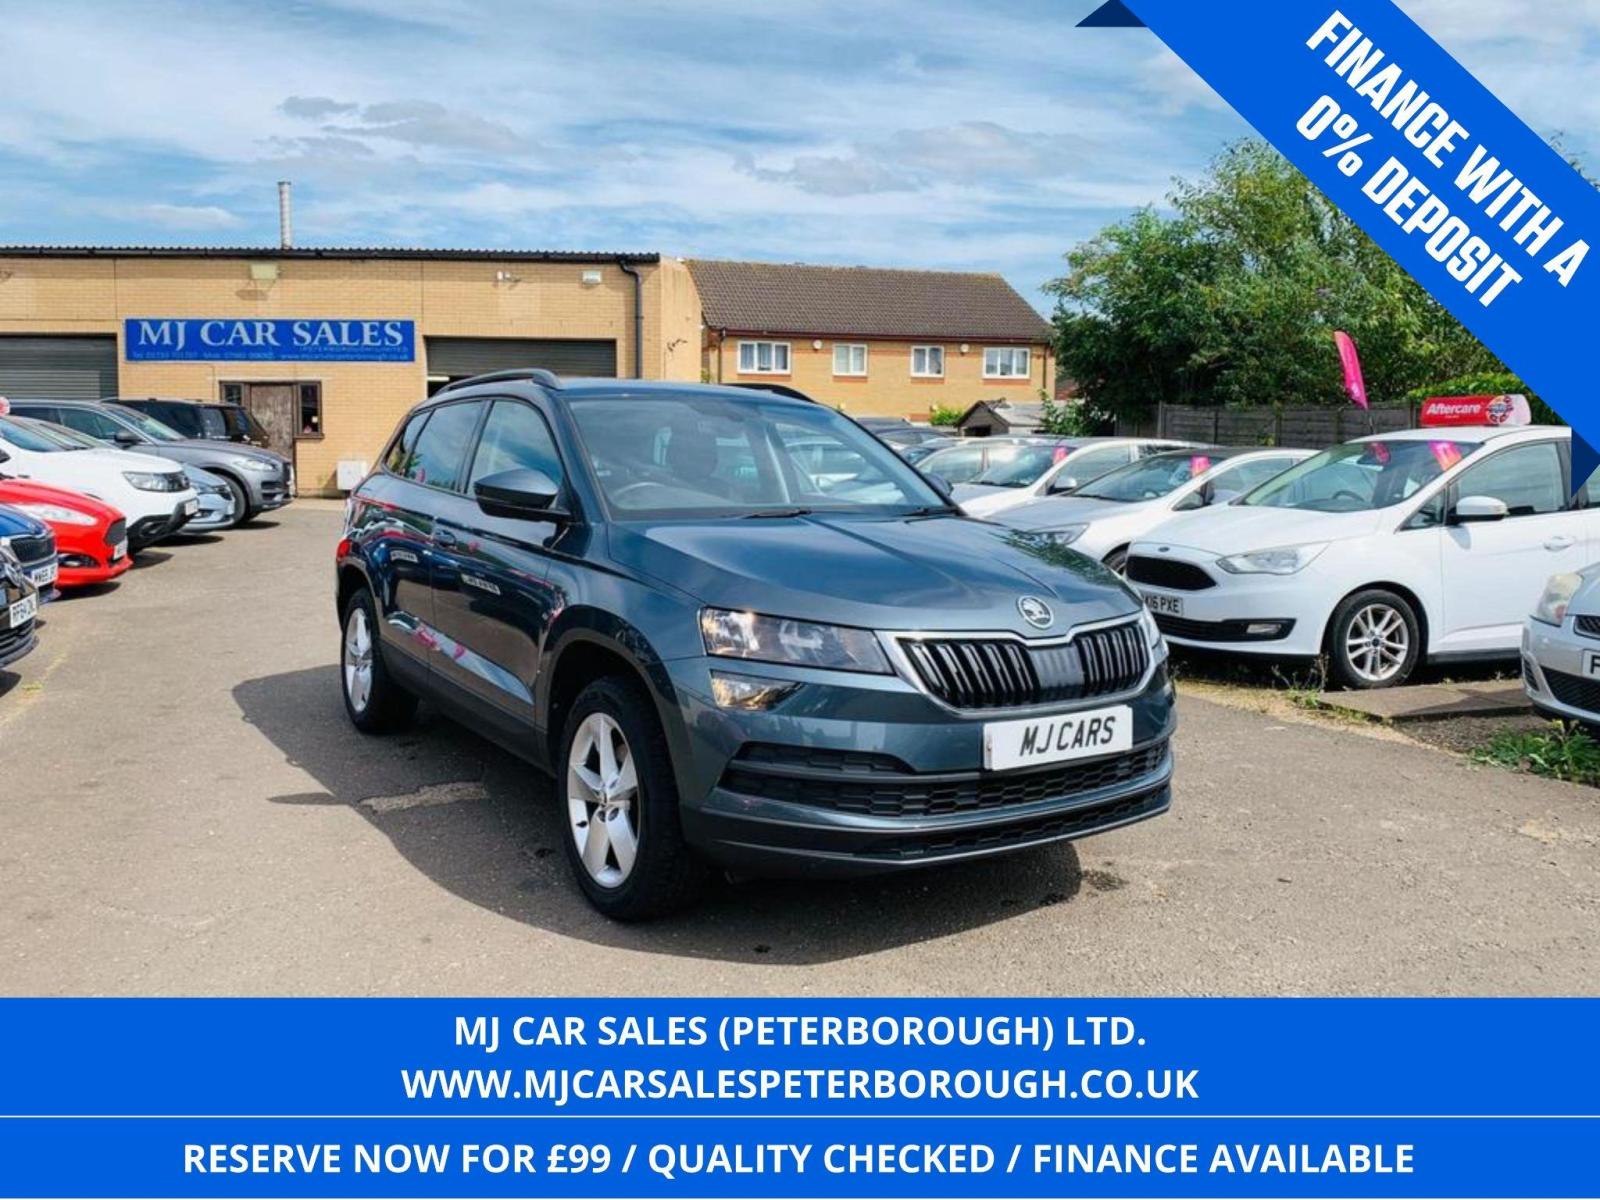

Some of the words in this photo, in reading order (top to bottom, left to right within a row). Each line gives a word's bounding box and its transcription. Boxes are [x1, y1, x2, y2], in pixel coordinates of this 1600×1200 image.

[138, 320, 187, 351] MJ
[199, 320, 281, 347] CAR
[292, 320, 404, 347] SALES
[1426, 403, 1482, 415] Aftercare
[1019, 723, 1055, 757] MJ
[1056, 715, 1116, 751] CARS
